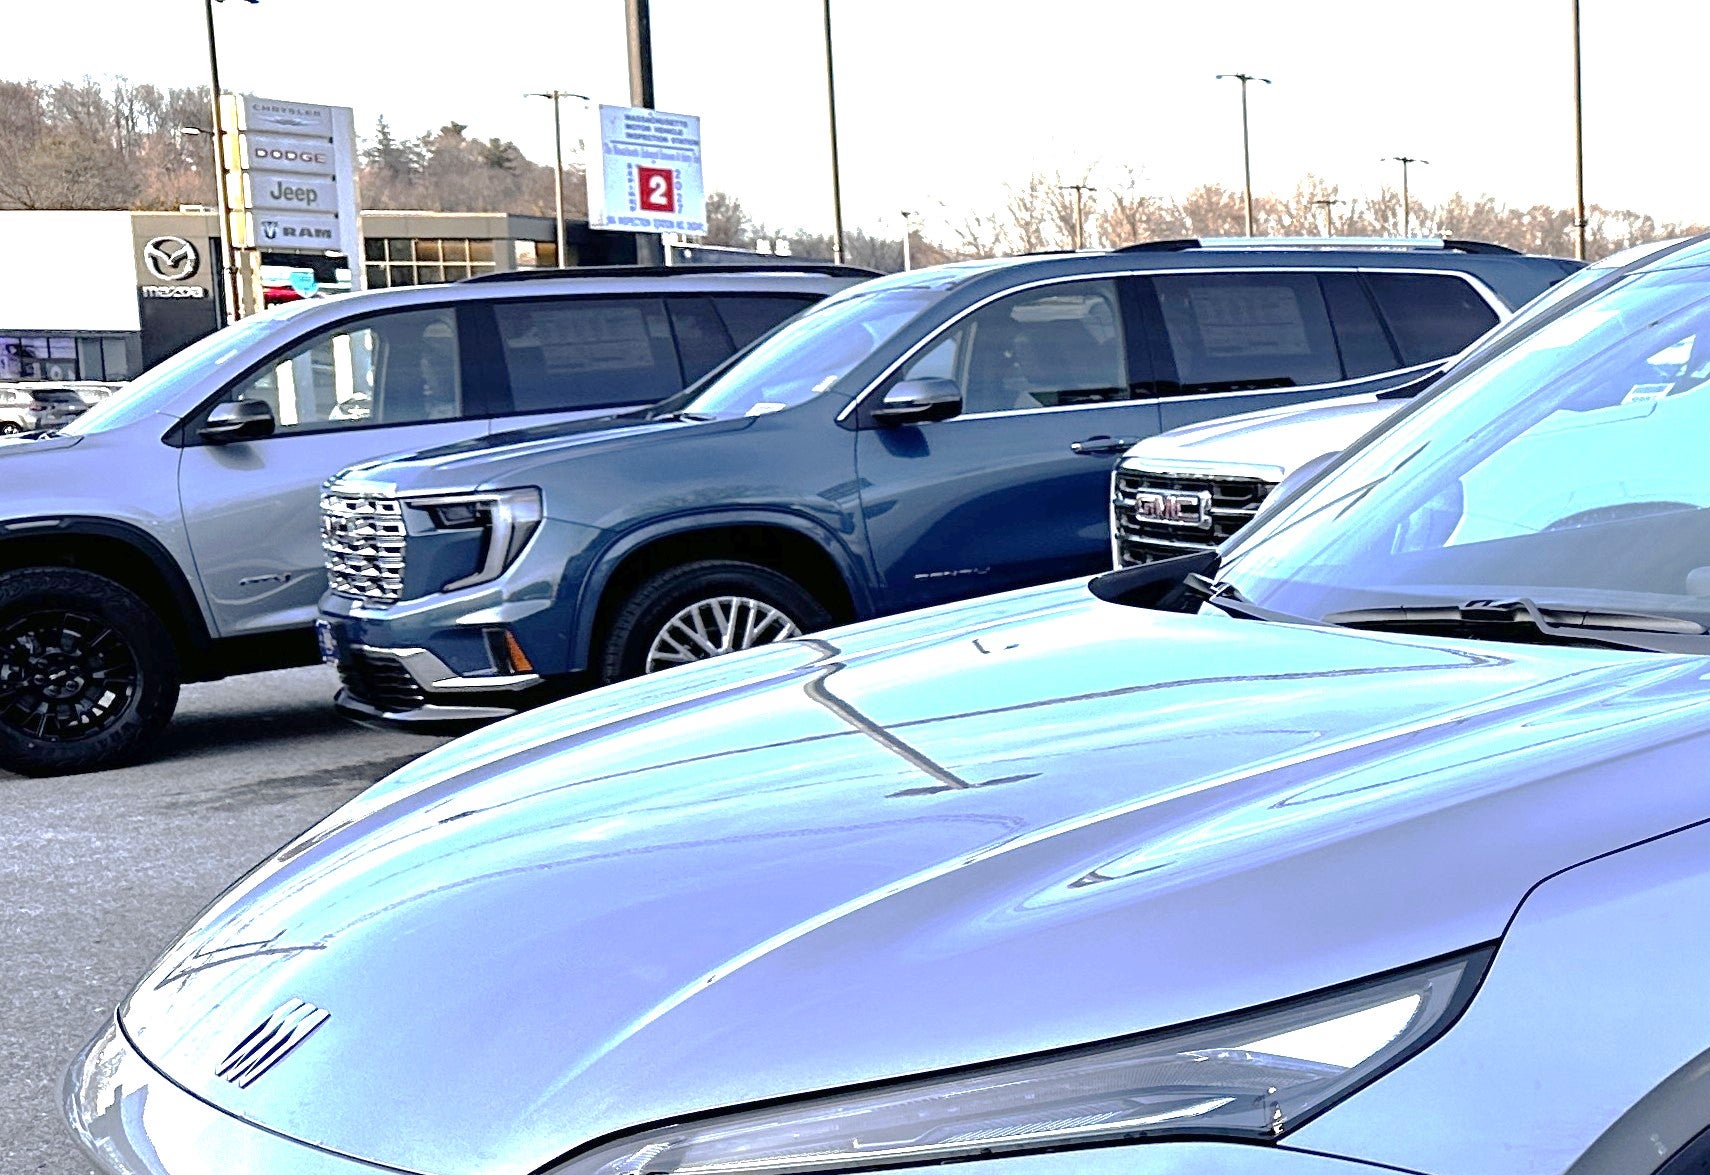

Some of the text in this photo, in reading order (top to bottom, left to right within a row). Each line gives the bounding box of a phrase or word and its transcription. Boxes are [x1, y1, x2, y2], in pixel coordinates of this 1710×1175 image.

[252, 103, 321, 117] CHRYSLER
[255, 147, 326, 164] DODGE
[270, 181, 318, 206] Jeep
[648, 175, 668, 205] 2
[283, 226, 332, 239] RAM
[1136, 493, 1199, 523] GMC
